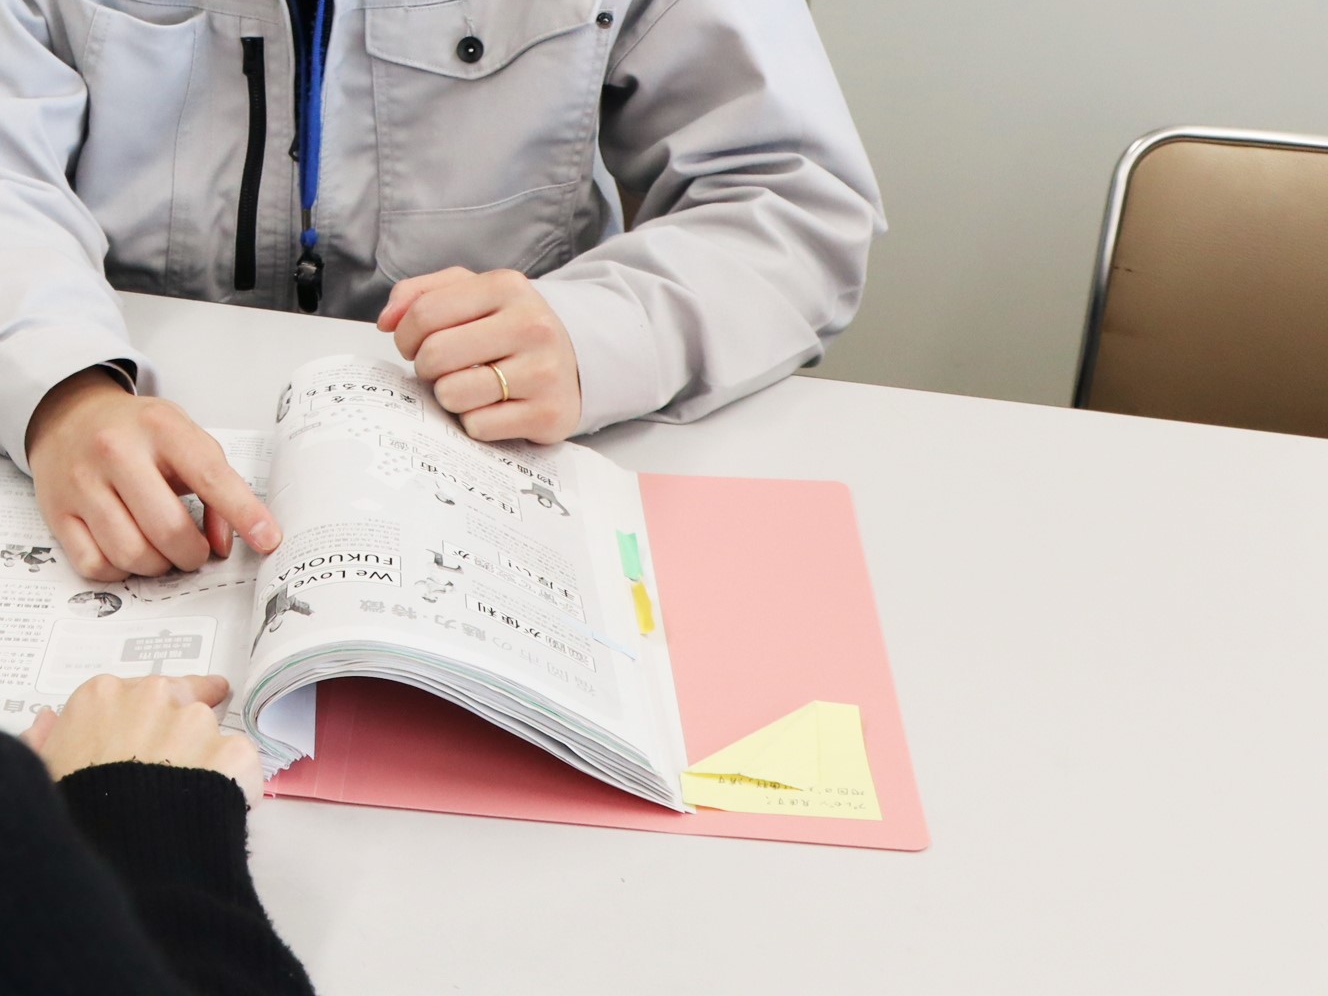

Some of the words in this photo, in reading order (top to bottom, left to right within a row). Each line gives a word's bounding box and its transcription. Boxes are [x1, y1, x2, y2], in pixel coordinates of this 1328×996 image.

[306, 383, 416, 406] 楽しめるまち
[417, 456, 516, 515] 住みたい街
[278, 553, 393, 582] FUKUOKA
[293, 569, 347, 590] Love
[355, 569, 394, 583] We
[359, 598, 600, 698] 福岡市の魅力・特徴
